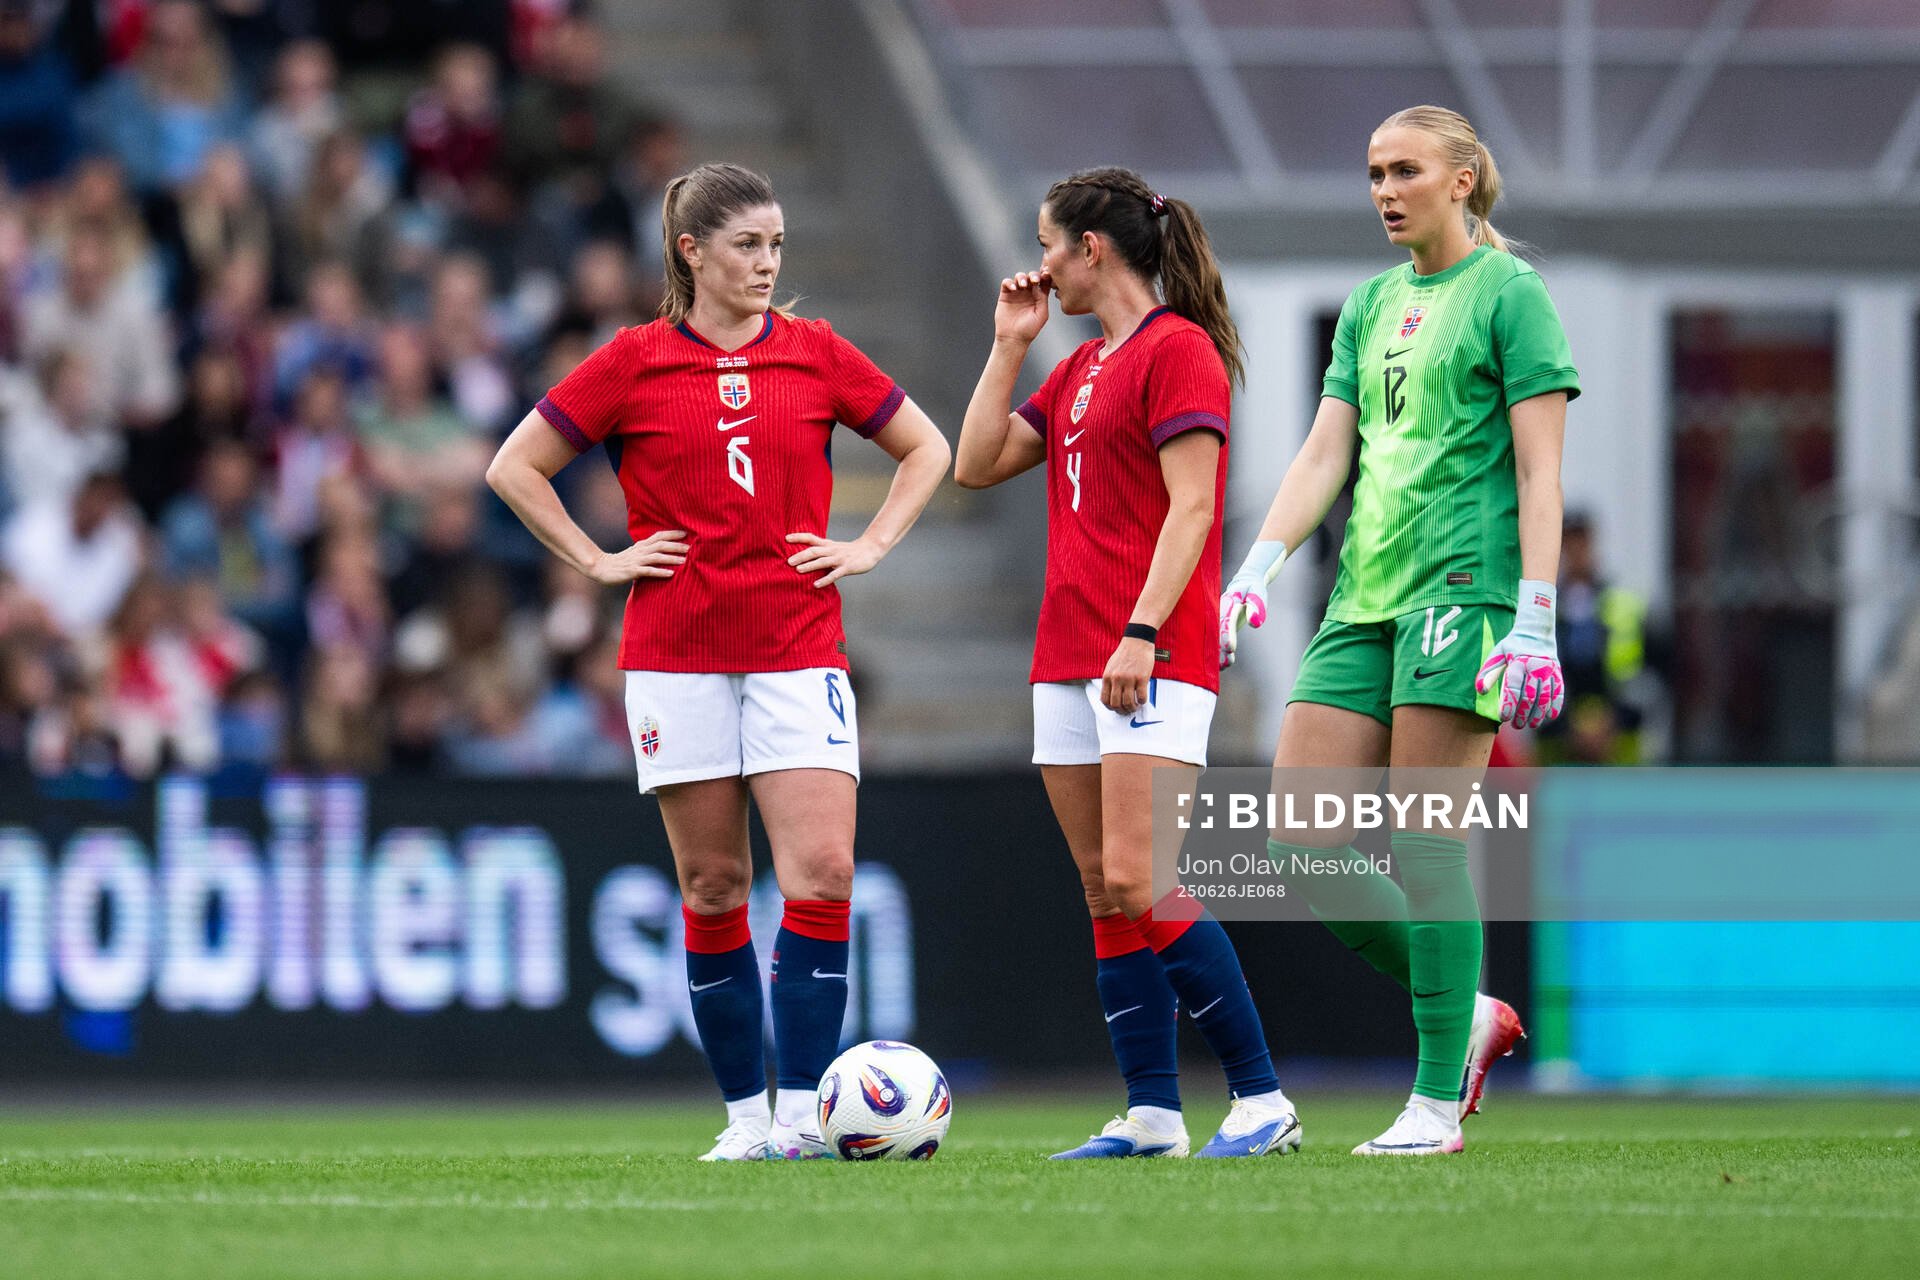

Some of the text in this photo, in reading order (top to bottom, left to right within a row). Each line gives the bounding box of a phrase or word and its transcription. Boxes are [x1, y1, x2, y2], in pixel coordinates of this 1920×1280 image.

[1382, 366, 1407, 426] 12
[726, 436, 754, 497] 6
[1066, 452, 1081, 512] 4
[1421, 605, 1462, 657] 12
[824, 672, 846, 728] 6
